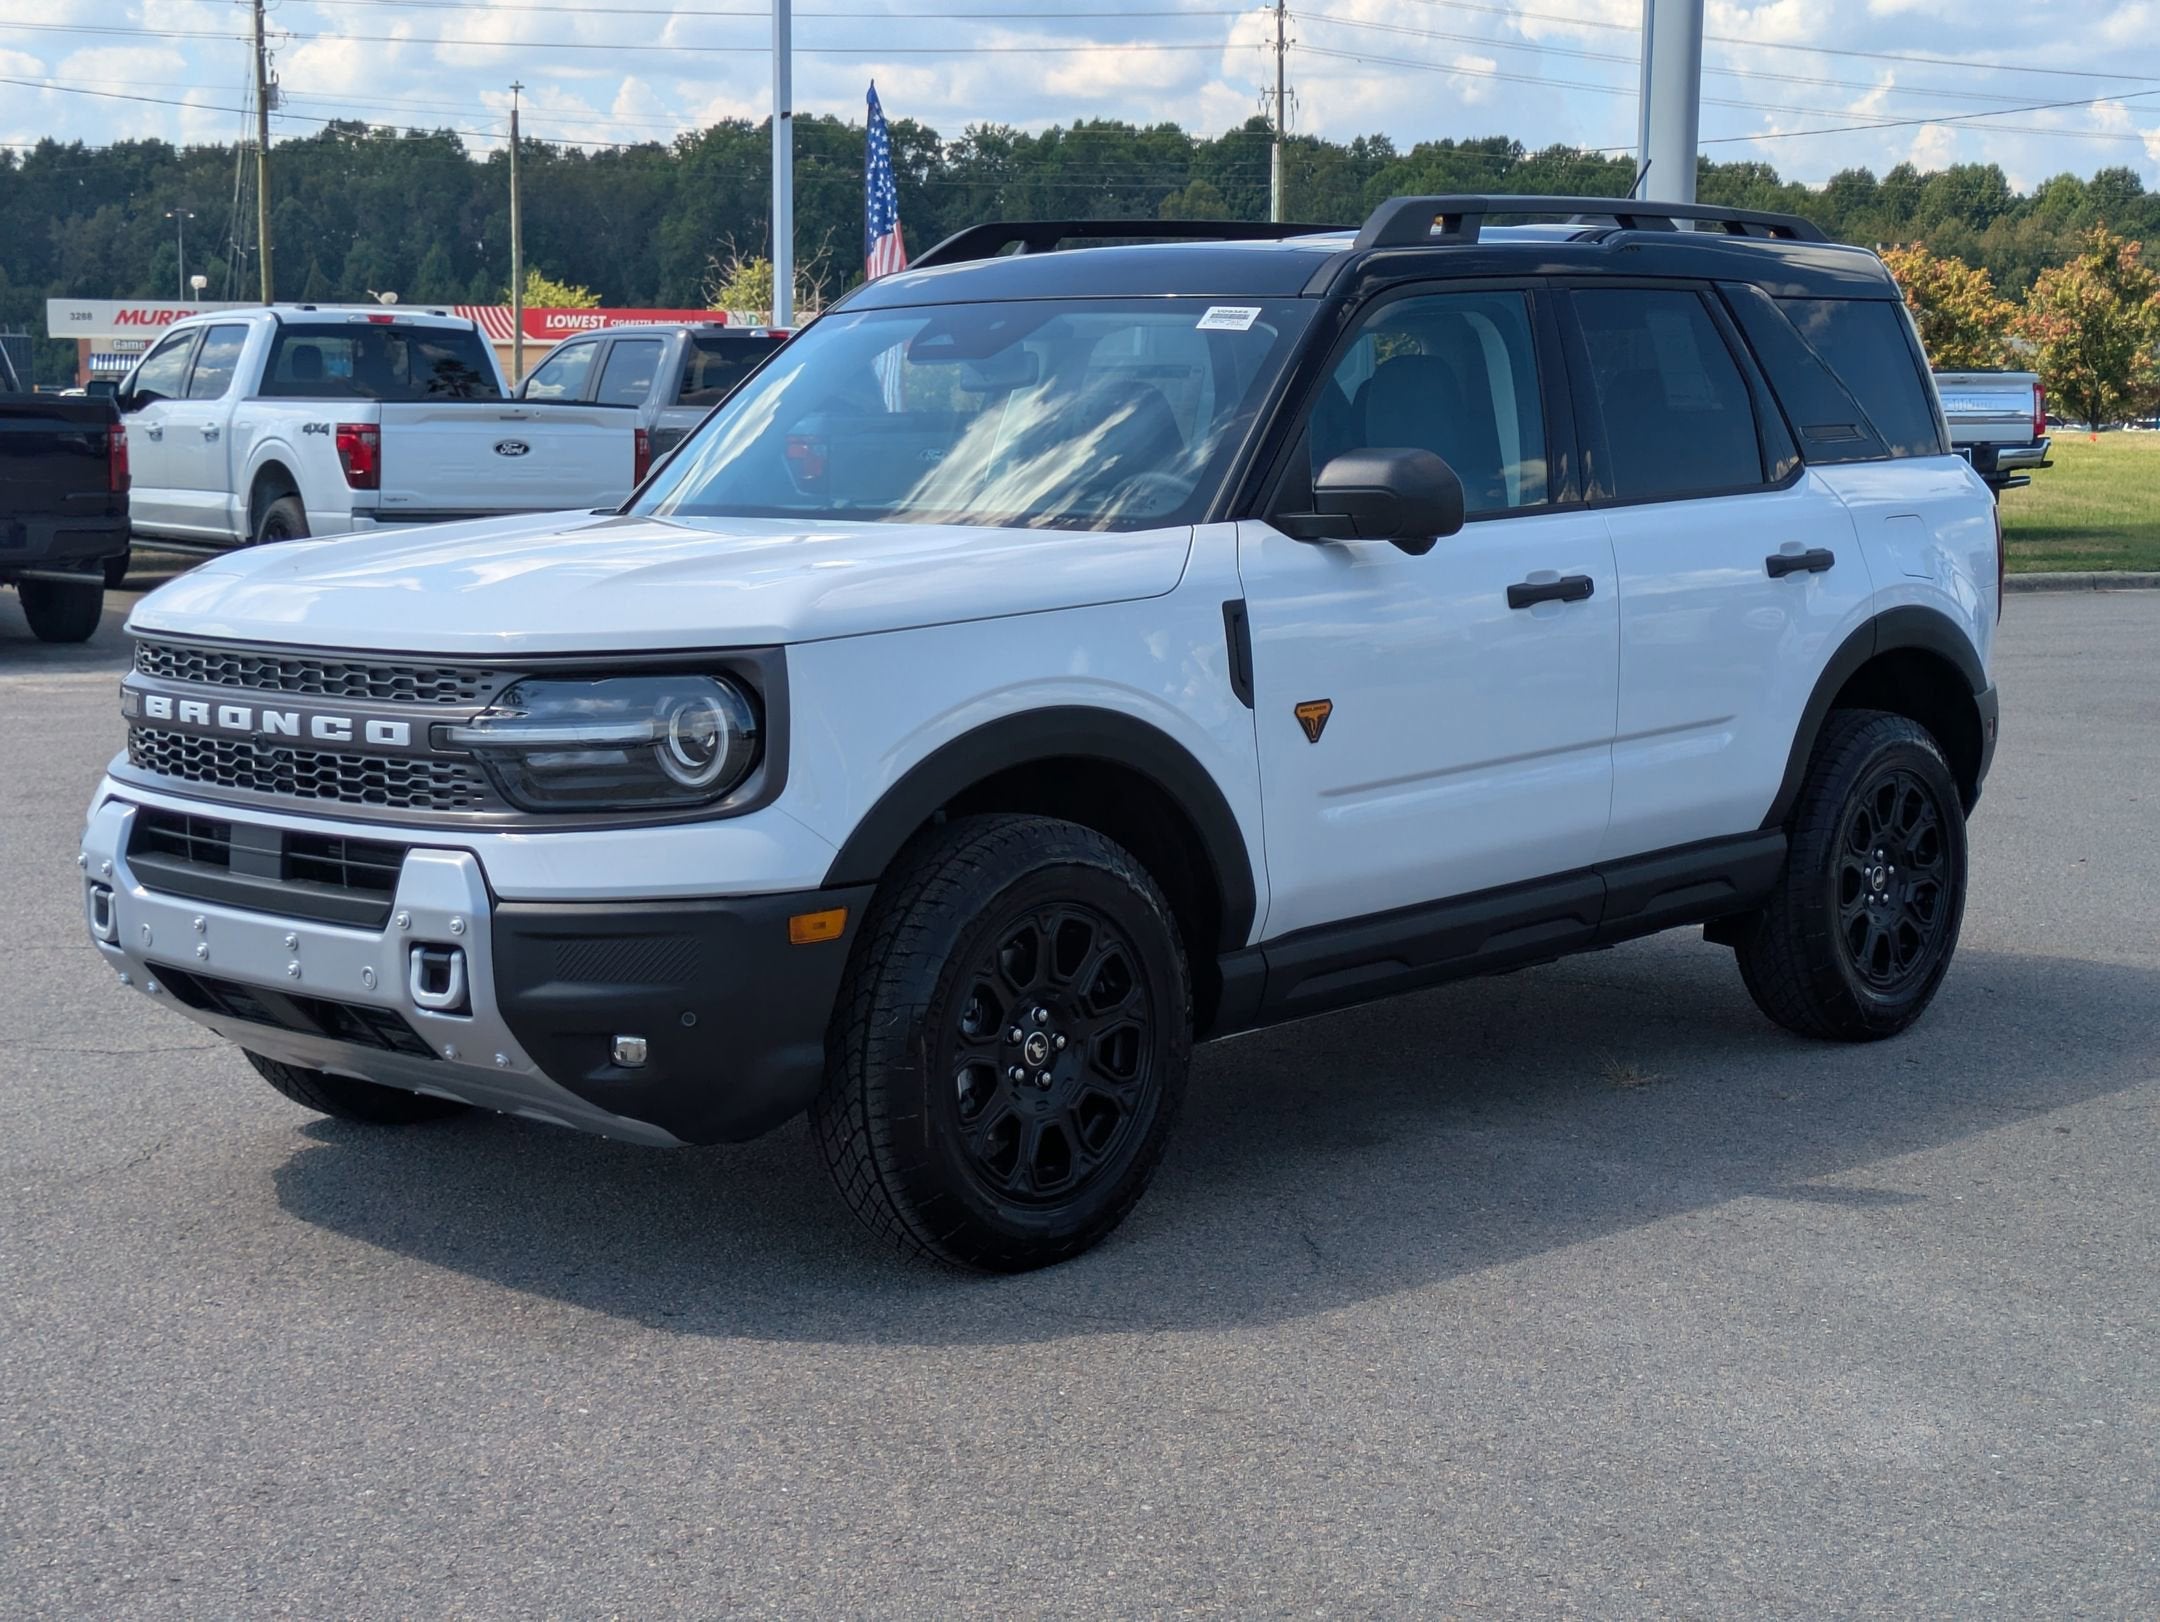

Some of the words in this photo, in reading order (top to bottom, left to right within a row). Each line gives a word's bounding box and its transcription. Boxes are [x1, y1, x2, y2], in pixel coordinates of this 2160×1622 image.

[545, 314, 607, 329] LOWEST
[500, 443, 525, 454] Ford
[145, 694, 412, 747] BRONCO
